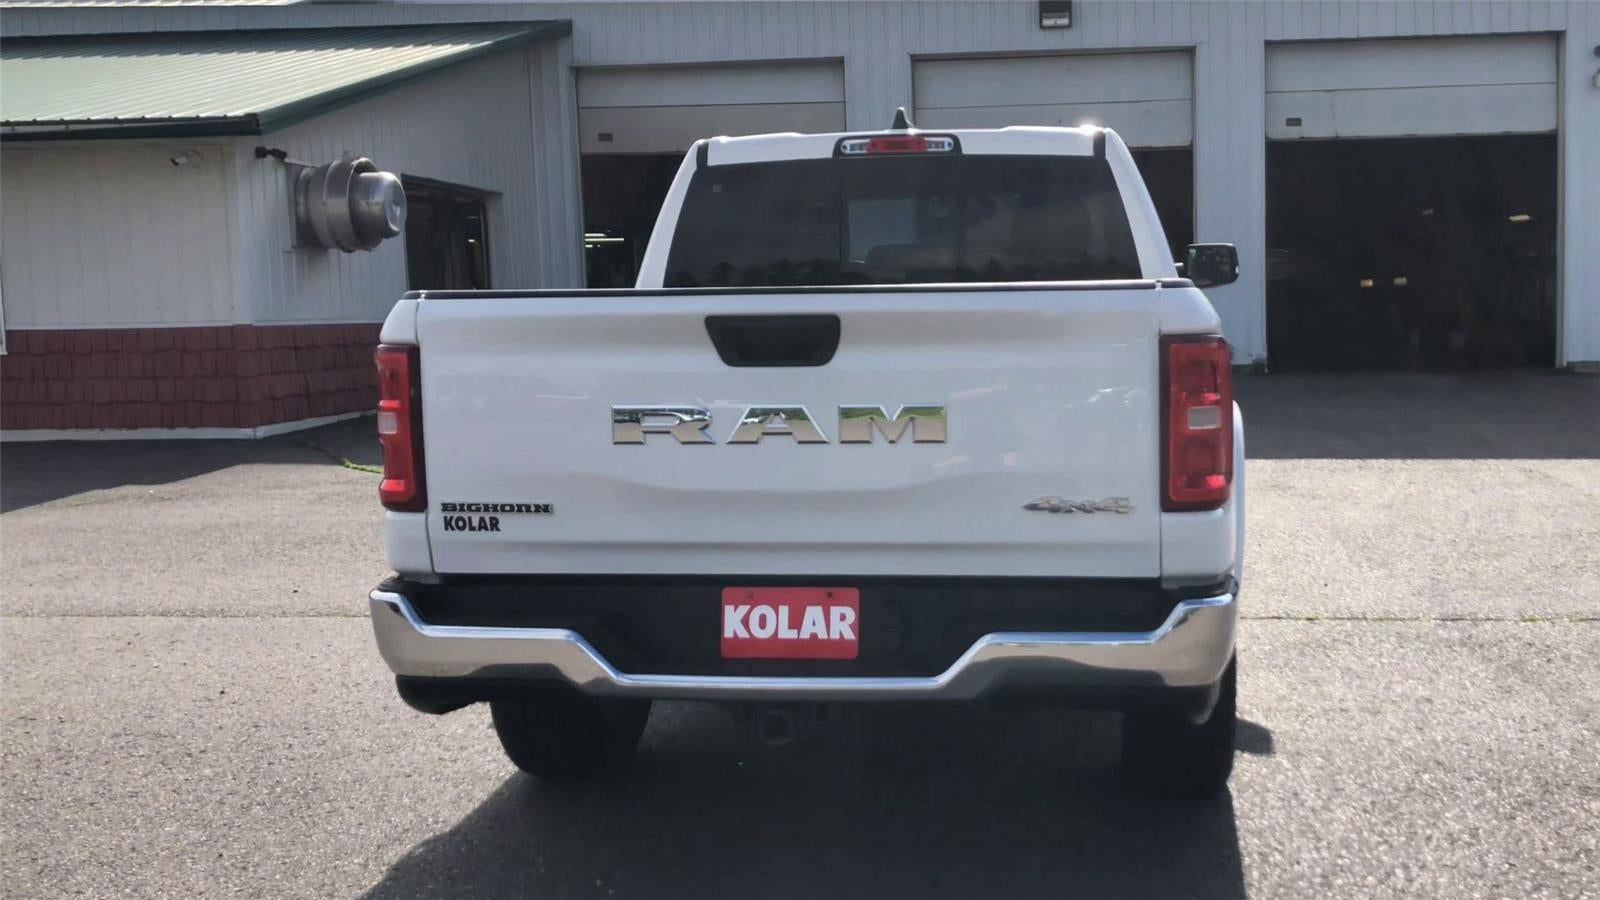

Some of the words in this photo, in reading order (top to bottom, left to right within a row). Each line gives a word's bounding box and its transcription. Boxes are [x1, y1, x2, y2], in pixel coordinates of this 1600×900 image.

[611, 404, 946, 444] RAM
[441, 503, 552, 513] BIGHORN
[443, 515, 501, 531] KOLAR
[724, 605, 856, 640] KOLAR
